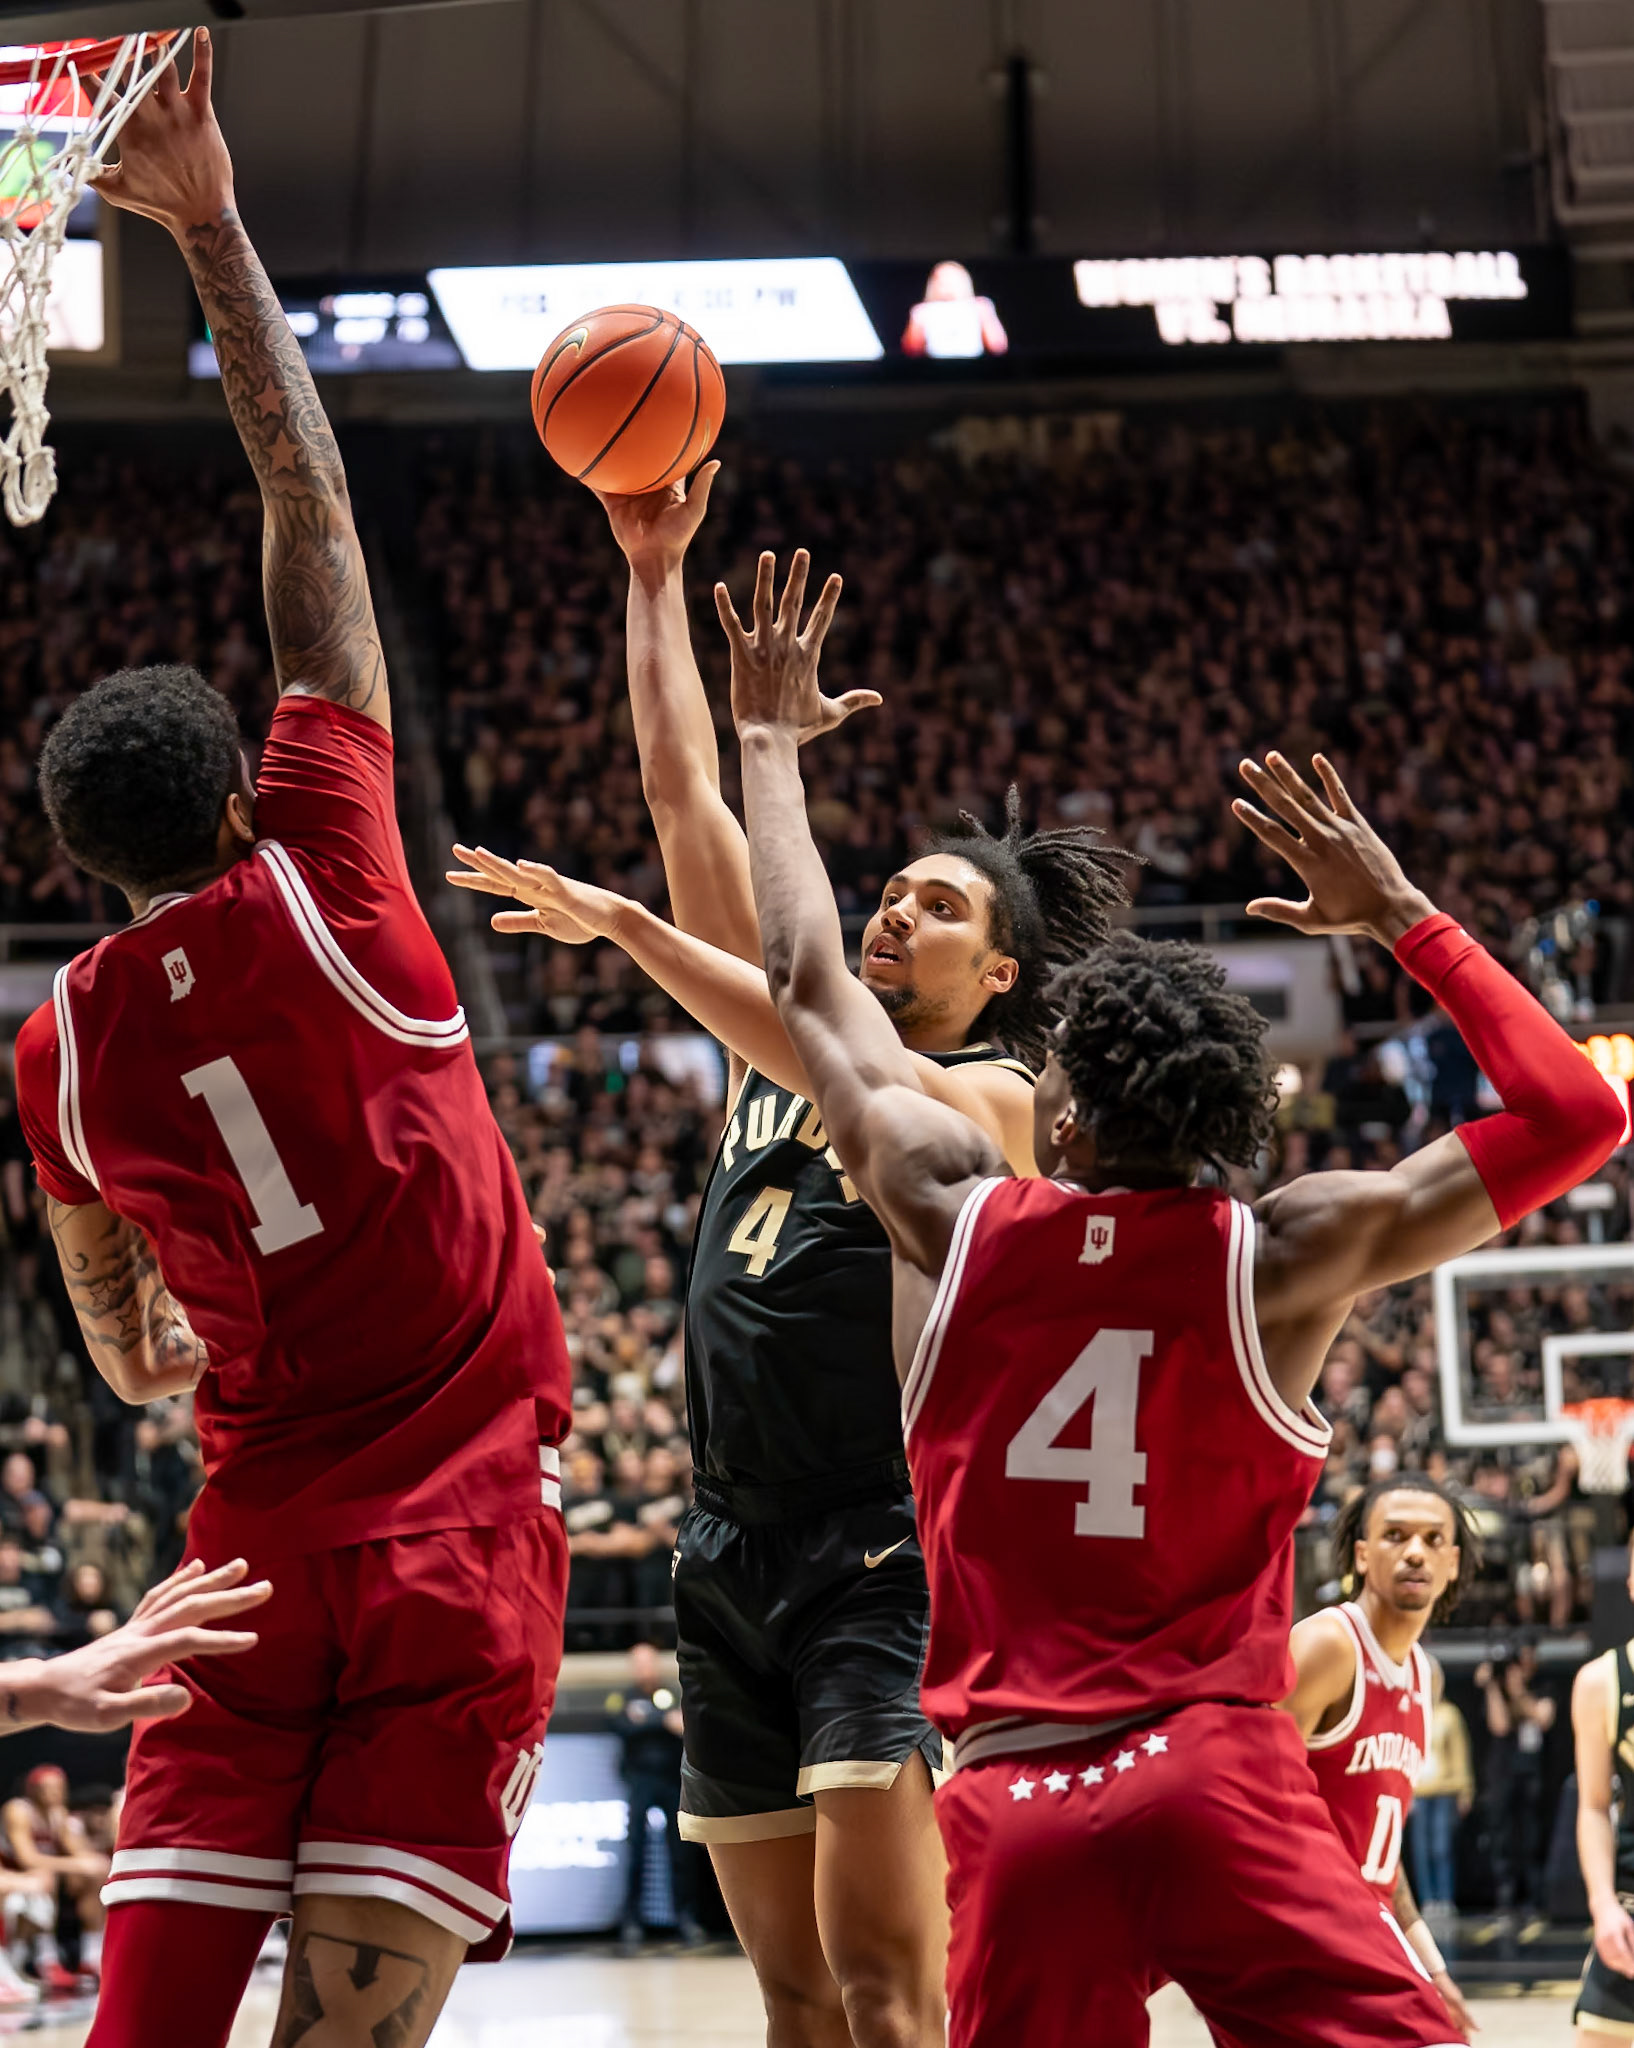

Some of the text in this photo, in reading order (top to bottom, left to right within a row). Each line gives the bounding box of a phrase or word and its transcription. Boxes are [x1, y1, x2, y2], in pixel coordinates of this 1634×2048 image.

[180, 1055, 325, 1257] 1
[726, 1185, 795, 1278] 4
[1005, 1328, 1155, 1540] 4
[1344, 1731, 1422, 1788] INDIAN
